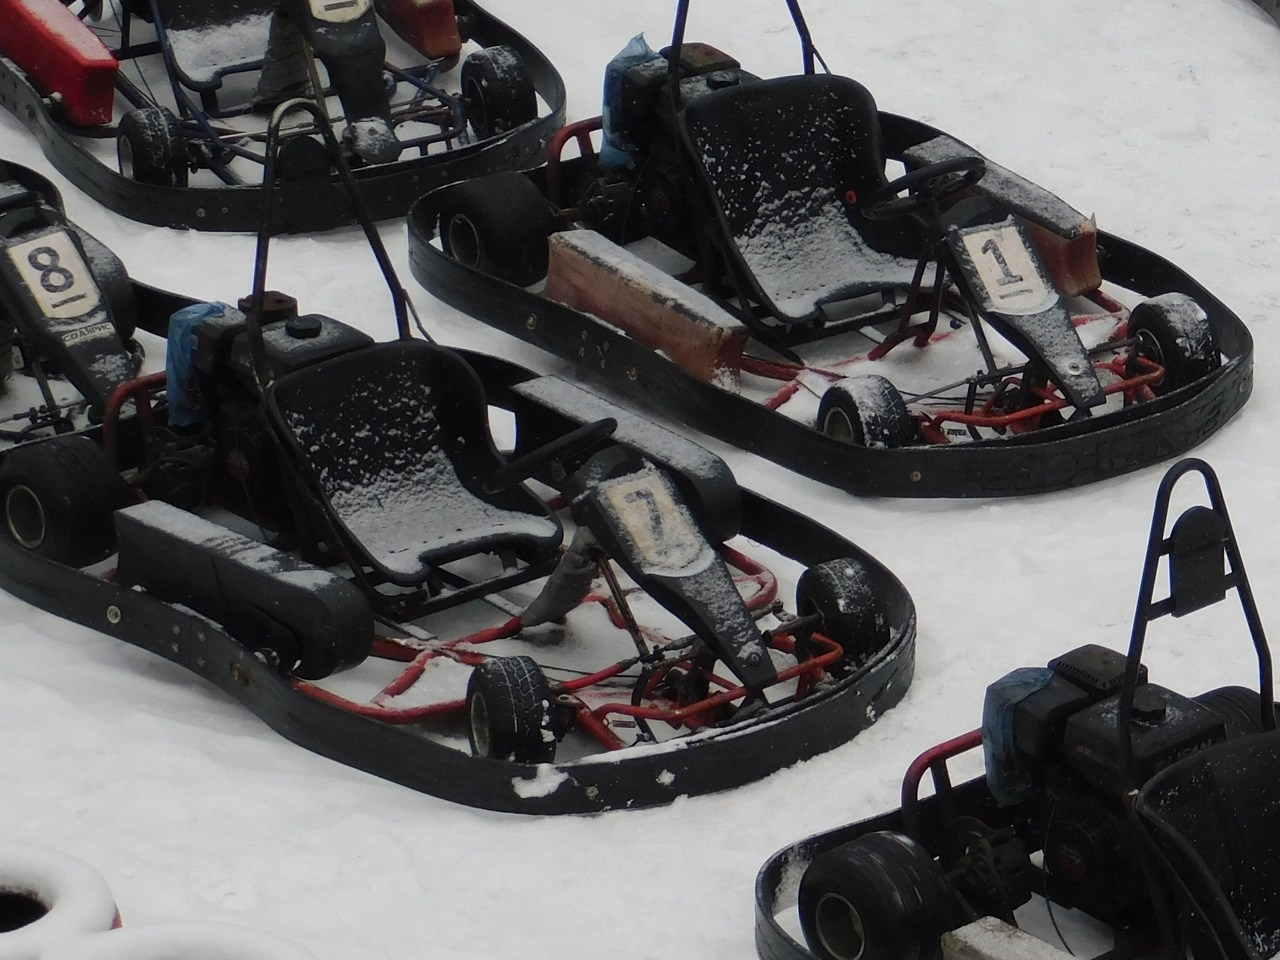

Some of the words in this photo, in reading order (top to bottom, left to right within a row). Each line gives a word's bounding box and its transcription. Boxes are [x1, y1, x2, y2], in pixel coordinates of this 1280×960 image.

[27, 246, 75, 294] 8
[980, 238, 1024, 287] 1
[623, 486, 665, 542] 7
